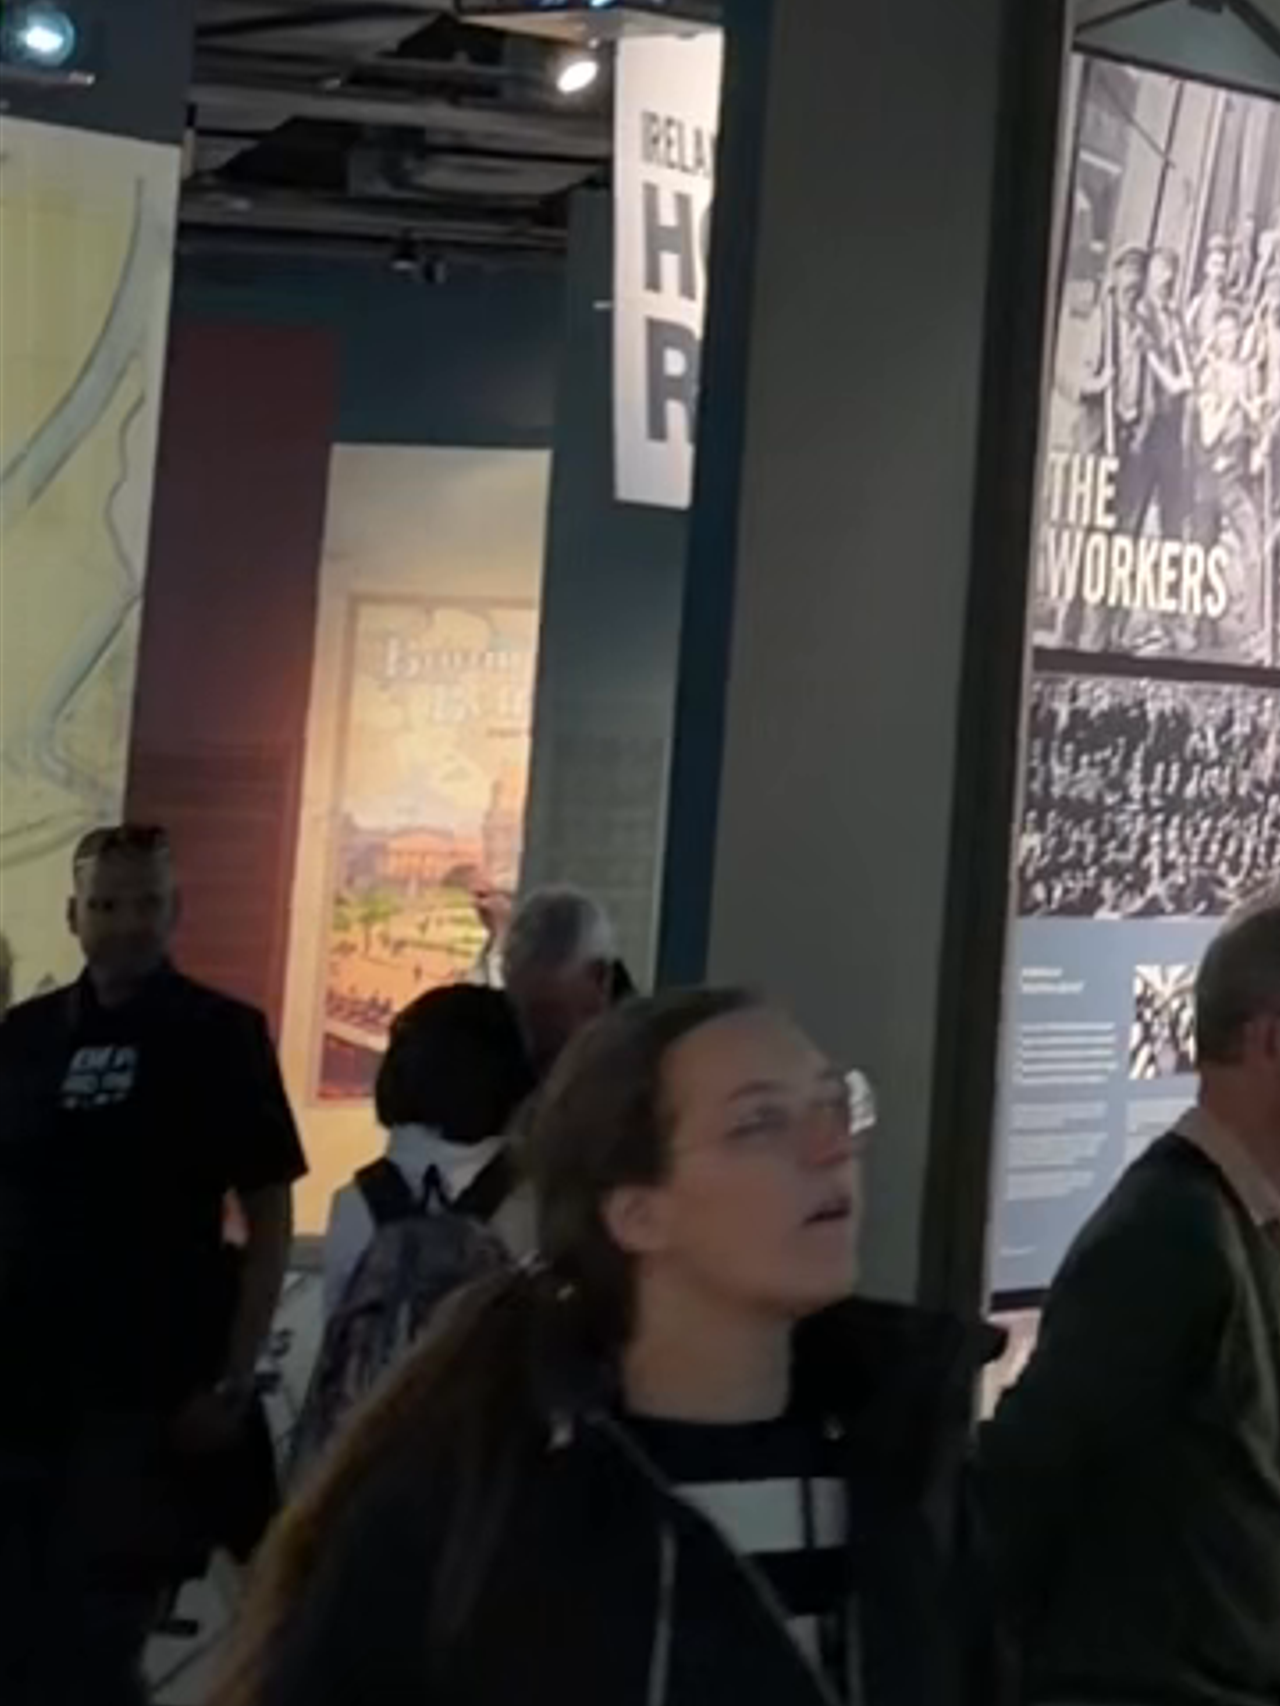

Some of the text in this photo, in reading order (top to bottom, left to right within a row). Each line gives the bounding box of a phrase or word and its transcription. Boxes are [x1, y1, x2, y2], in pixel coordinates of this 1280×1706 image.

[641, 110, 716, 180] IRELA
[643, 182, 710, 302] H
[1048, 453, 1119, 529] THE
[1047, 529, 1229, 619] WORKERS
